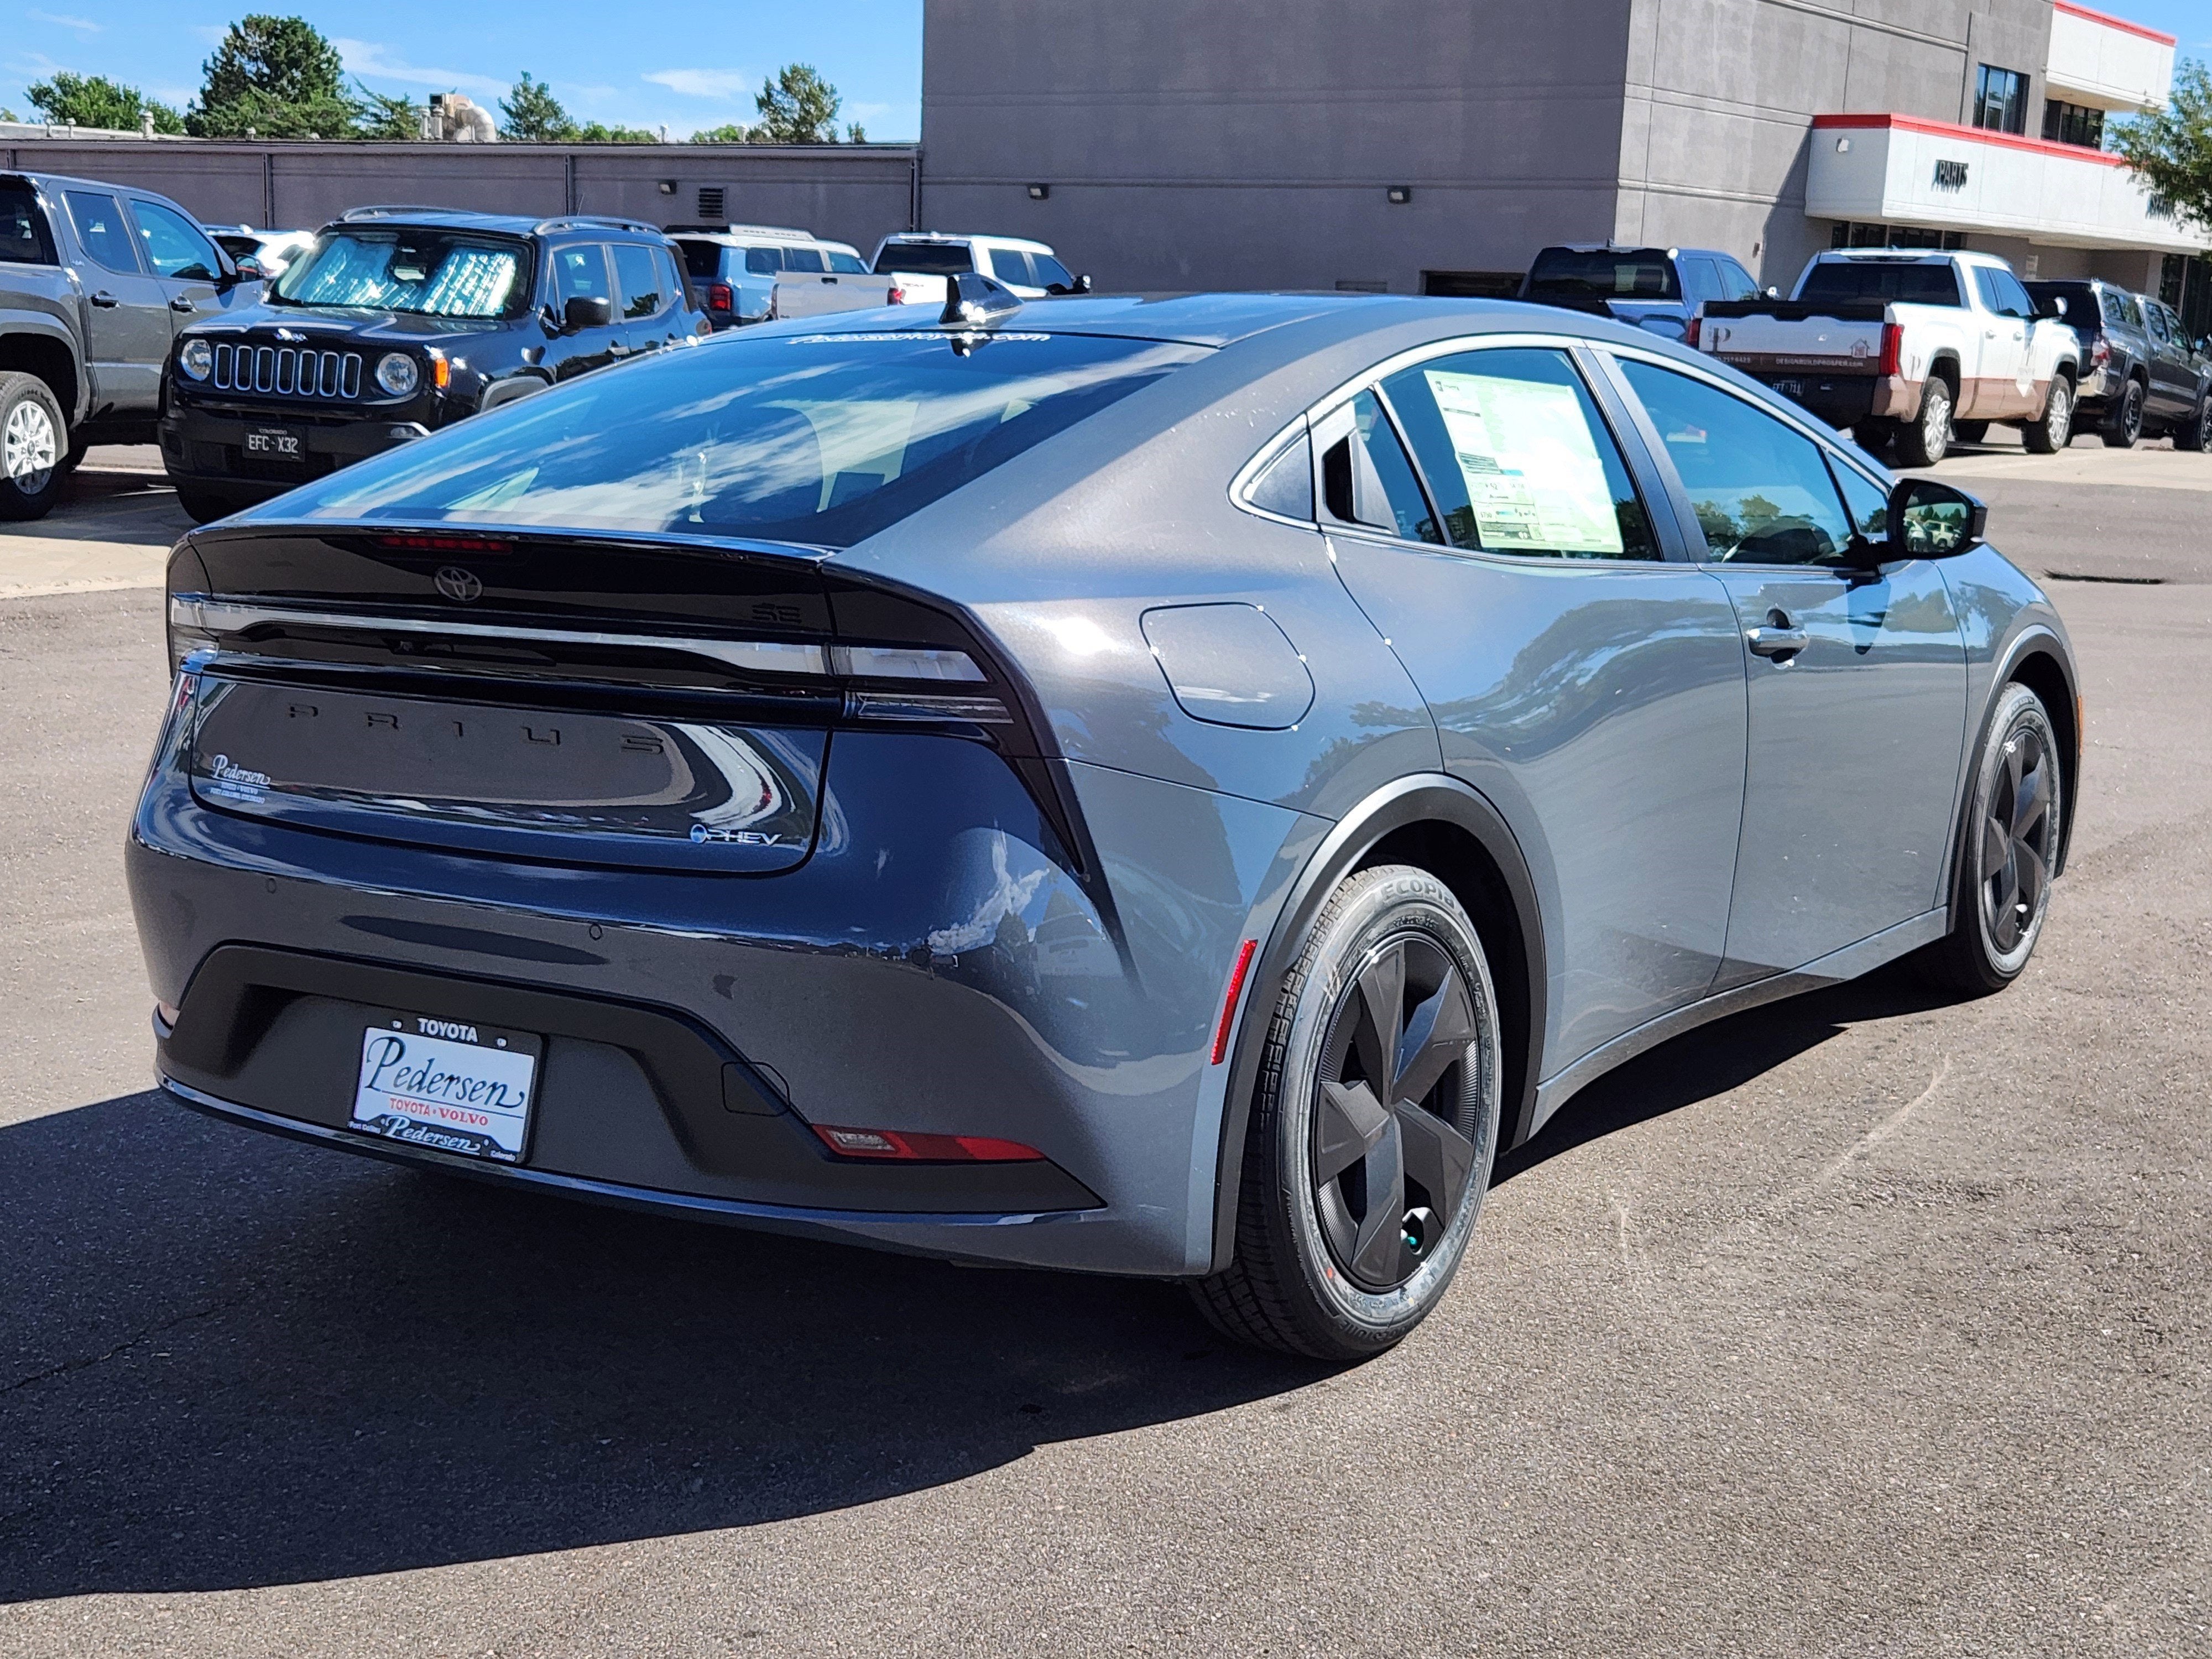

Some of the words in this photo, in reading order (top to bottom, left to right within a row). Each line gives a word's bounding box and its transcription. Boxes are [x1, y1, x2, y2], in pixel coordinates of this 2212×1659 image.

[1936, 159, 1969, 187] PARTS
[288, 702, 664, 755] PRIUS
[211, 754, 271, 785] Pedersen
[417, 1017, 478, 1043] TOYOTA
[364, 1036, 525, 1109] Pedersen
[389, 1097, 431, 1116] TOYOTA
[439, 1107, 489, 1126] VOLVO
[382, 1115, 481, 1152] Pedersen
